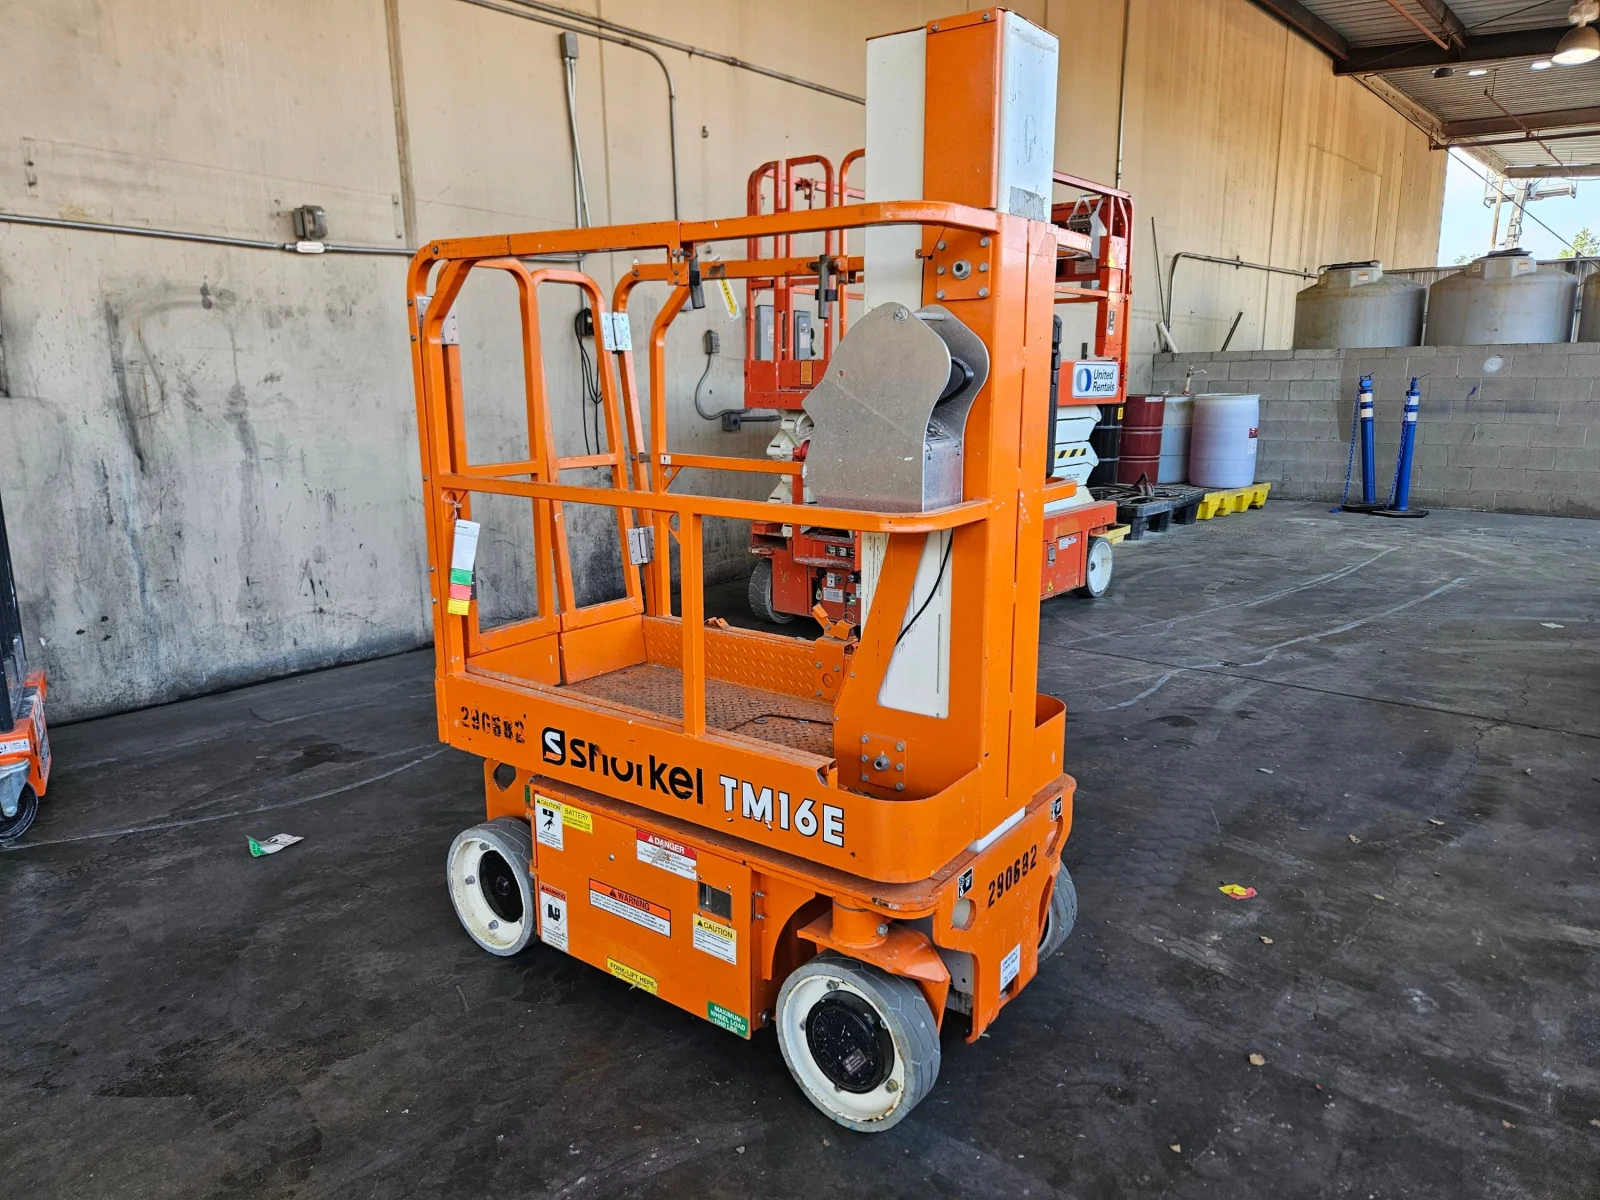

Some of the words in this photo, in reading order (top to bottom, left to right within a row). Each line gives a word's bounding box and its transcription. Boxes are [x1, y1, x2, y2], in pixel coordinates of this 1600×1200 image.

[1093, 369, 1115, 380] United
[1092, 381, 1115, 392] Rentals
[540, 799, 561, 811] CAUTION
[564, 807, 590, 821] BATTERY
[719, 775, 845, 848] TM16E
[654, 836, 685, 855] DANGER
[617, 891, 650, 911] WARNING
[703, 921, 733, 939] CAUTION
[710, 1009, 730, 1024] WHEEL
[730, 1019, 746, 1032] LOAD
[714, 1005, 742, 1023] MAXIMUM
